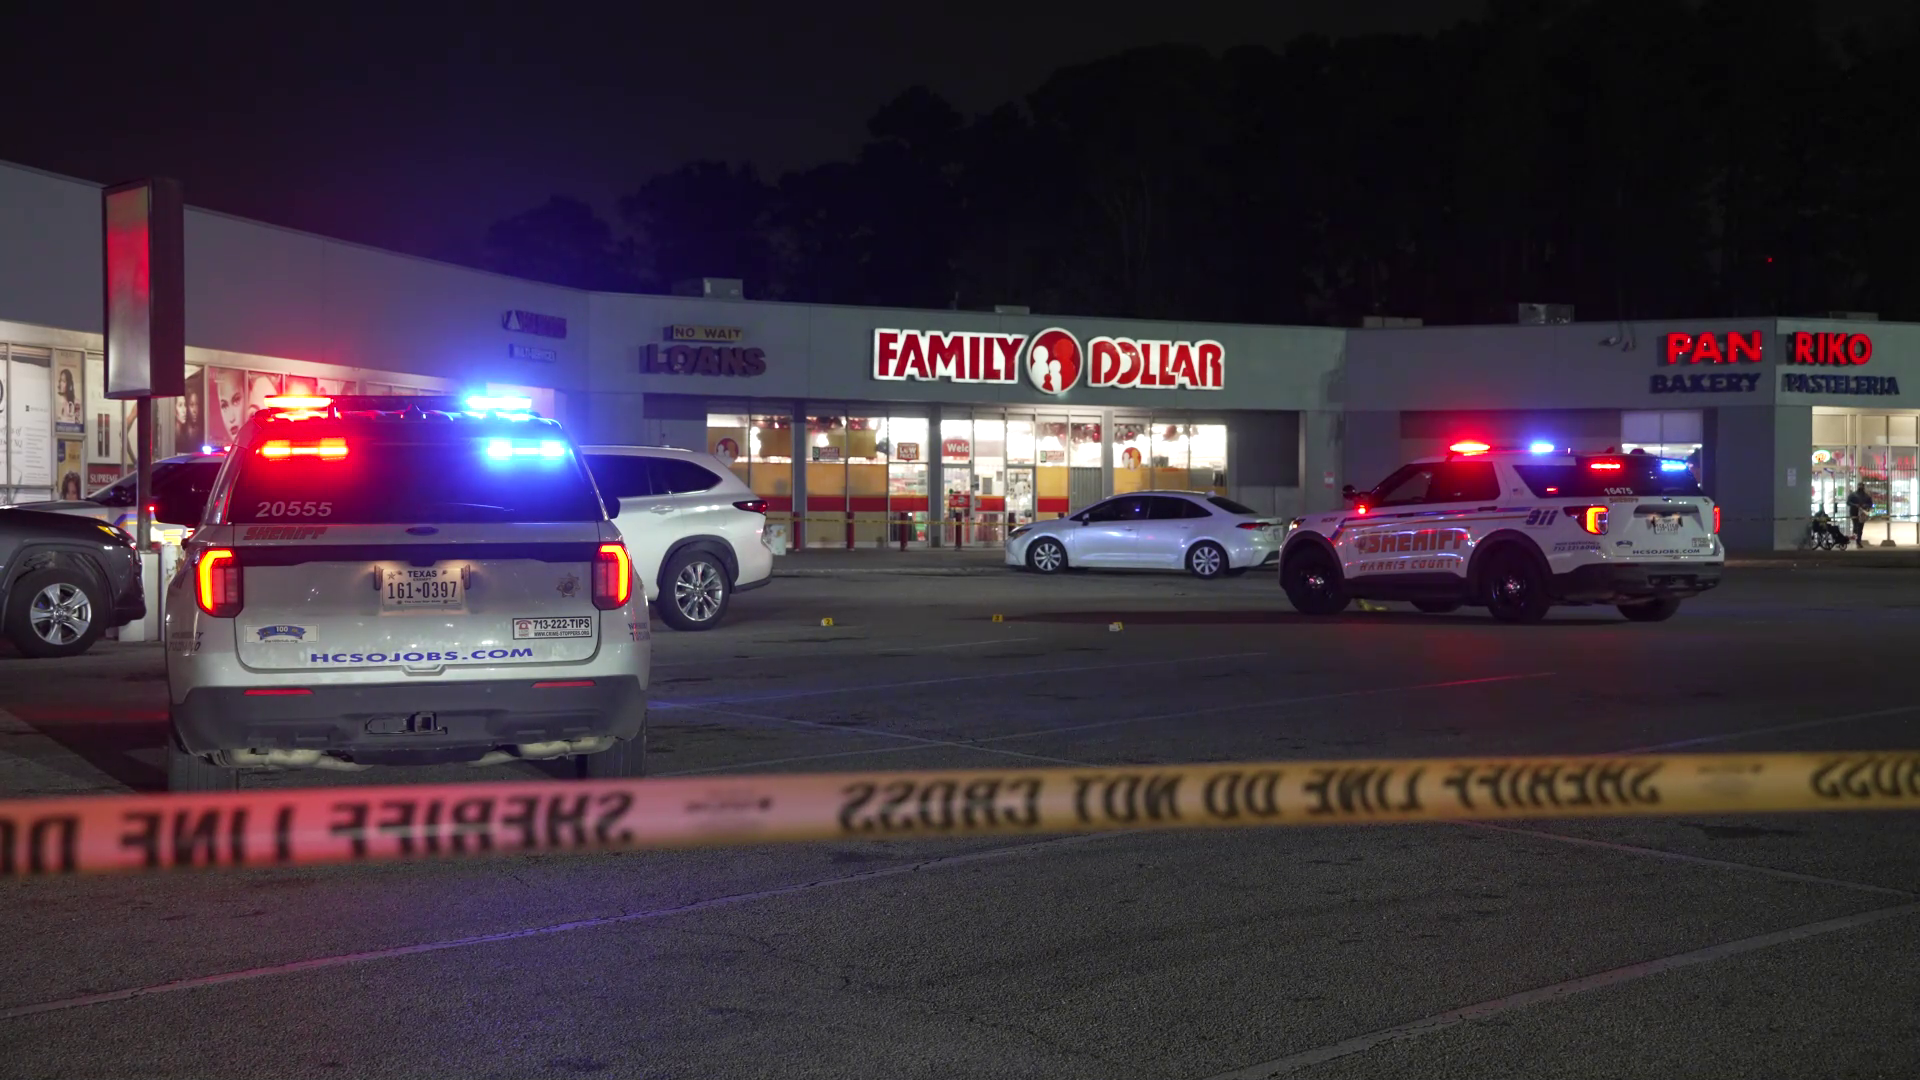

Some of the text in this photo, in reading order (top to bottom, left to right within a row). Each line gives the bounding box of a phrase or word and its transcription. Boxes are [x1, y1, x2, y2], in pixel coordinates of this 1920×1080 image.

[675, 328, 741, 339] NO WAIT
[1667, 330, 1873, 365] PAN RIKO
[646, 344, 767, 377] LOANS
[874, 329, 1224, 389] FAMILY DOLLAR
[1651, 373, 1900, 395] BAKERY PASTELERIA
[947, 443, 970, 452] Welc
[1603, 487, 1633, 495] 16475
[255, 501, 333, 518] 20555
[1525, 509, 1558, 525] 911
[243, 526, 329, 541] SHERIFF
[1367, 526, 1471, 553] SHERIFF
[1360, 558, 1462, 571] HARRIS COUNTY
[407, 570, 437, 578] TEXAS
[533, 618, 590, 630] 713-222-TIPS
[311, 647, 533, 663] HCSOJOBS.COM
